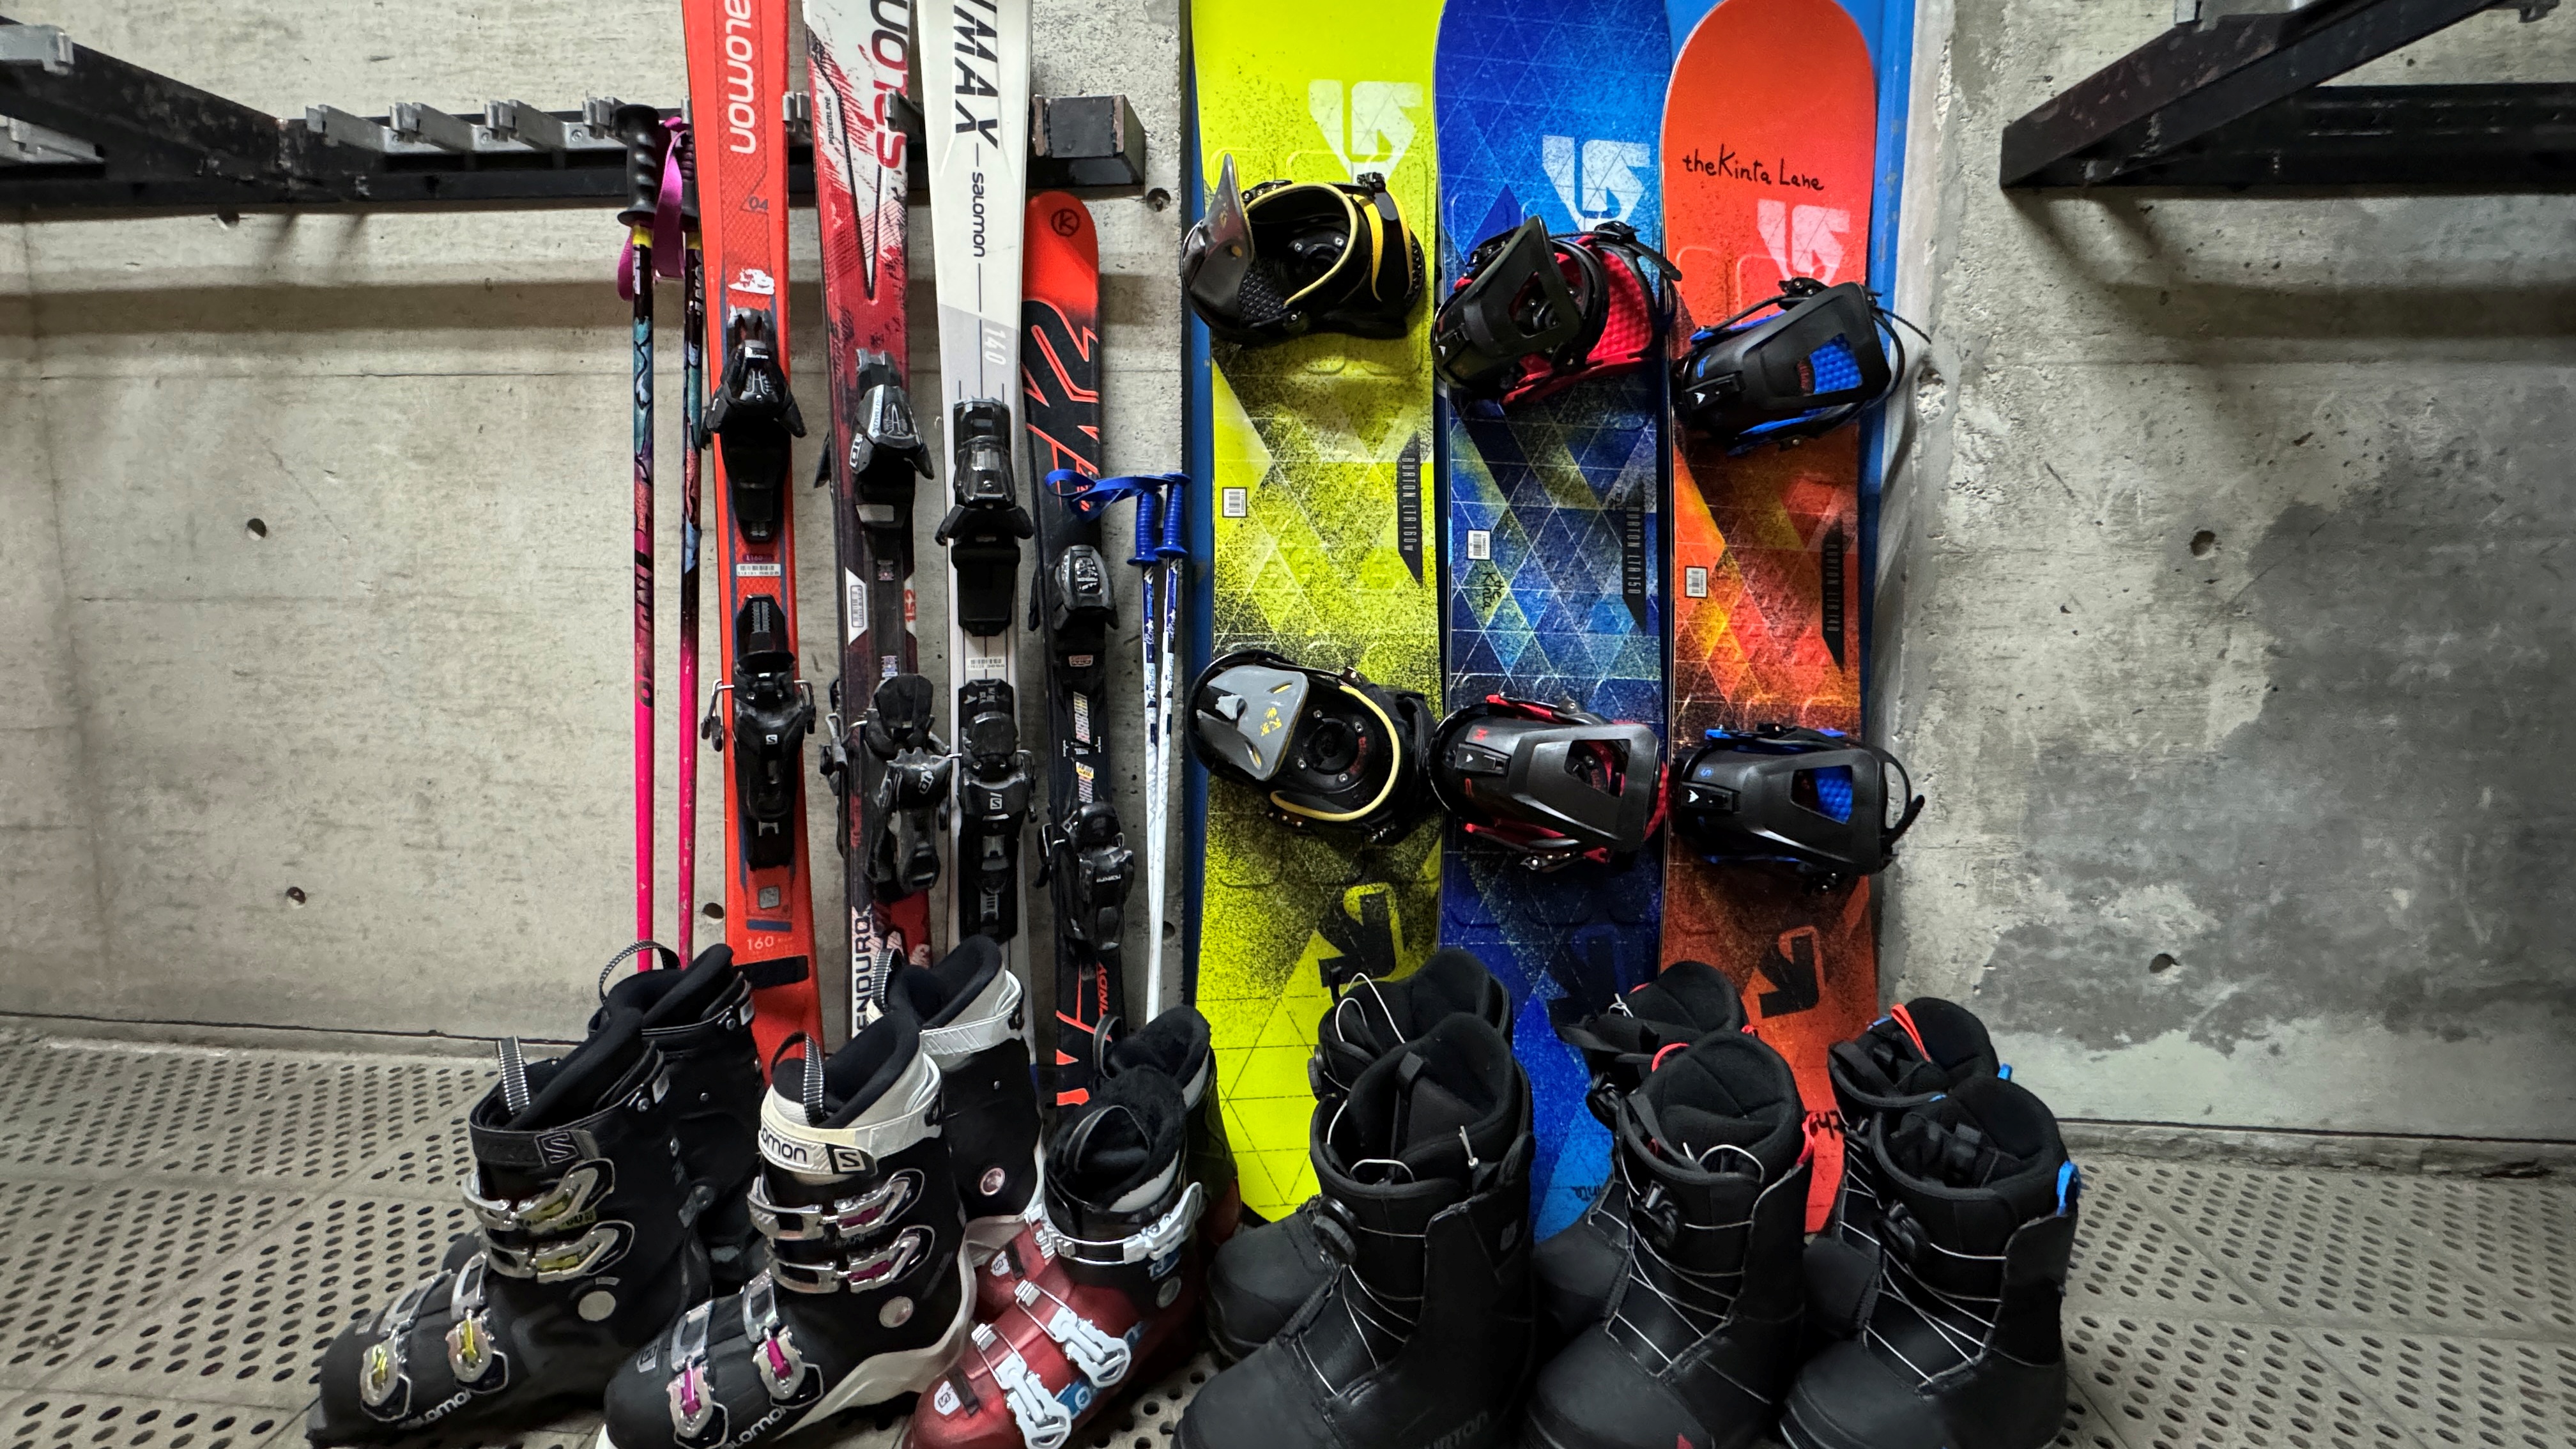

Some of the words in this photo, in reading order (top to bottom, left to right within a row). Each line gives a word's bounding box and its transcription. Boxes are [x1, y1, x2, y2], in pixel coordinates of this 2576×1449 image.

[725, 0, 756, 154] alomon
[1779, 158, 1824, 191] Lane
[972, 172, 985, 257] salomon
[984, 327, 1006, 366] 140
[1402, 457, 1416, 498] BURTON
[1626, 507, 1640, 548] BURTON
[1826, 544, 1839, 585] BURTON
[1482, 572, 1496, 611] Kinta
[1492, 579, 1505, 599] the
[746, 936, 774, 950] 160
[760, 1126, 808, 1163] omon
[839, 1152, 861, 1168] S
